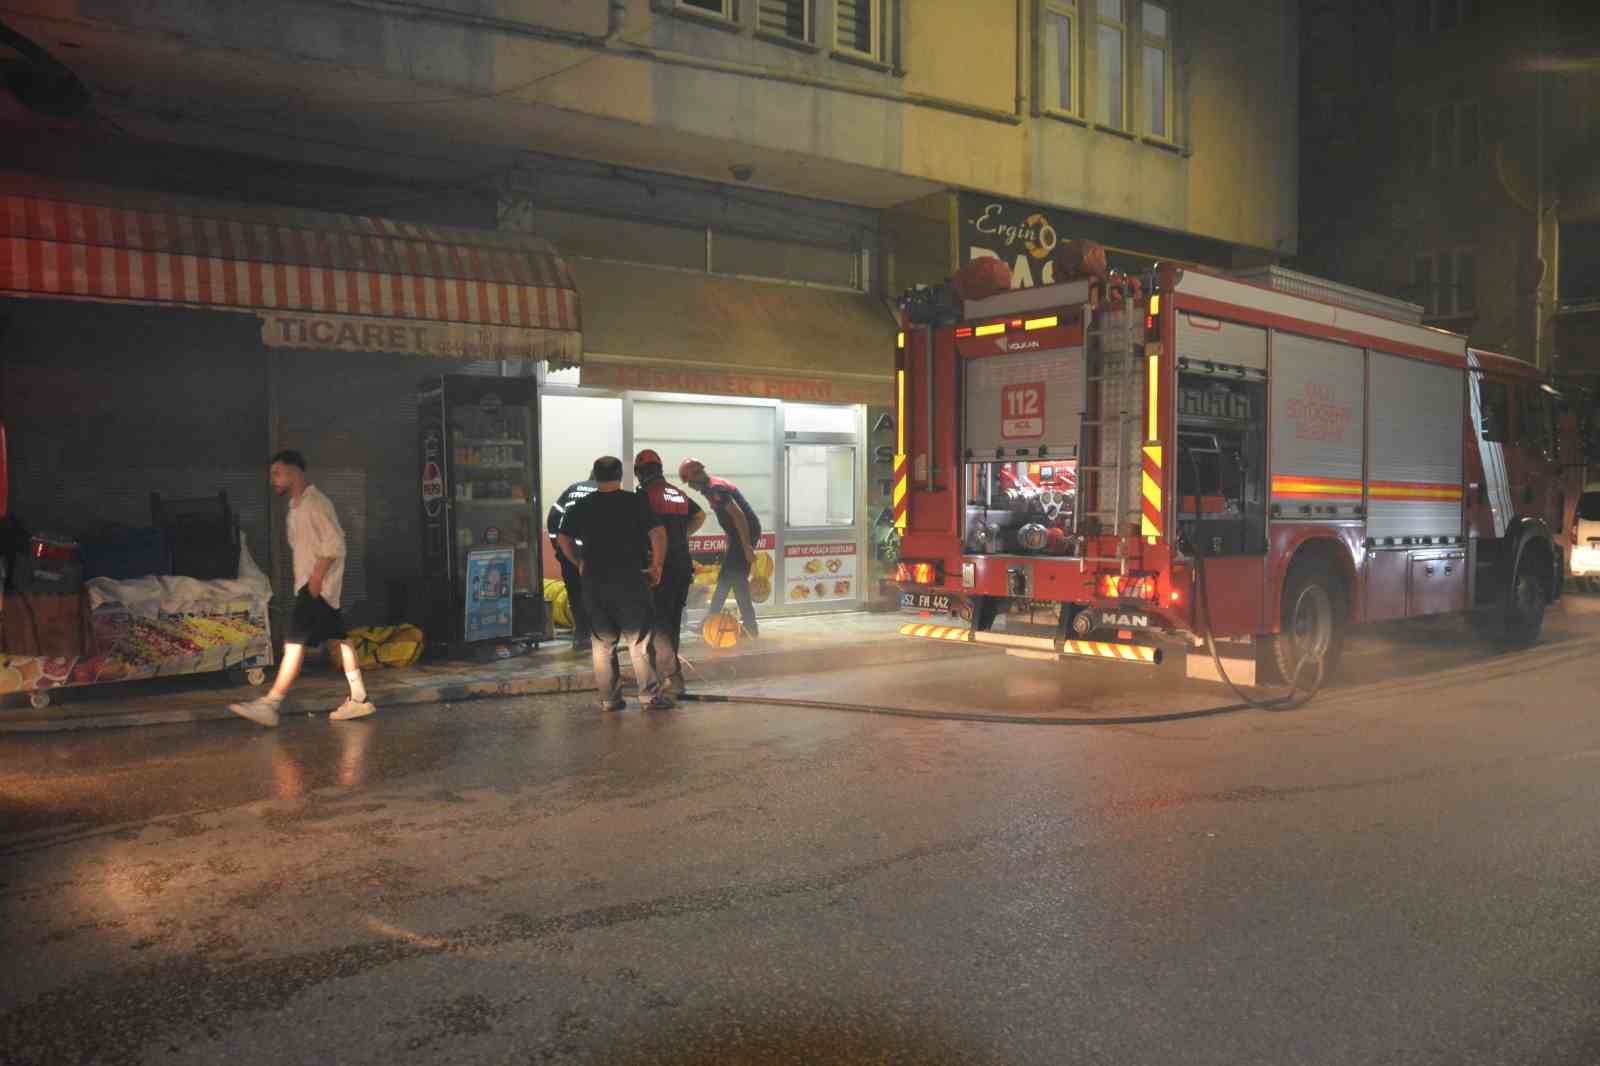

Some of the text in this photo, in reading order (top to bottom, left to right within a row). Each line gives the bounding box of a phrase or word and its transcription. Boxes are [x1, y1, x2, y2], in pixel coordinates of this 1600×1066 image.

[976, 204, 1035, 246] Ergin
[1008, 389, 1039, 416] 112
[1102, 613, 1148, 626] MAN
